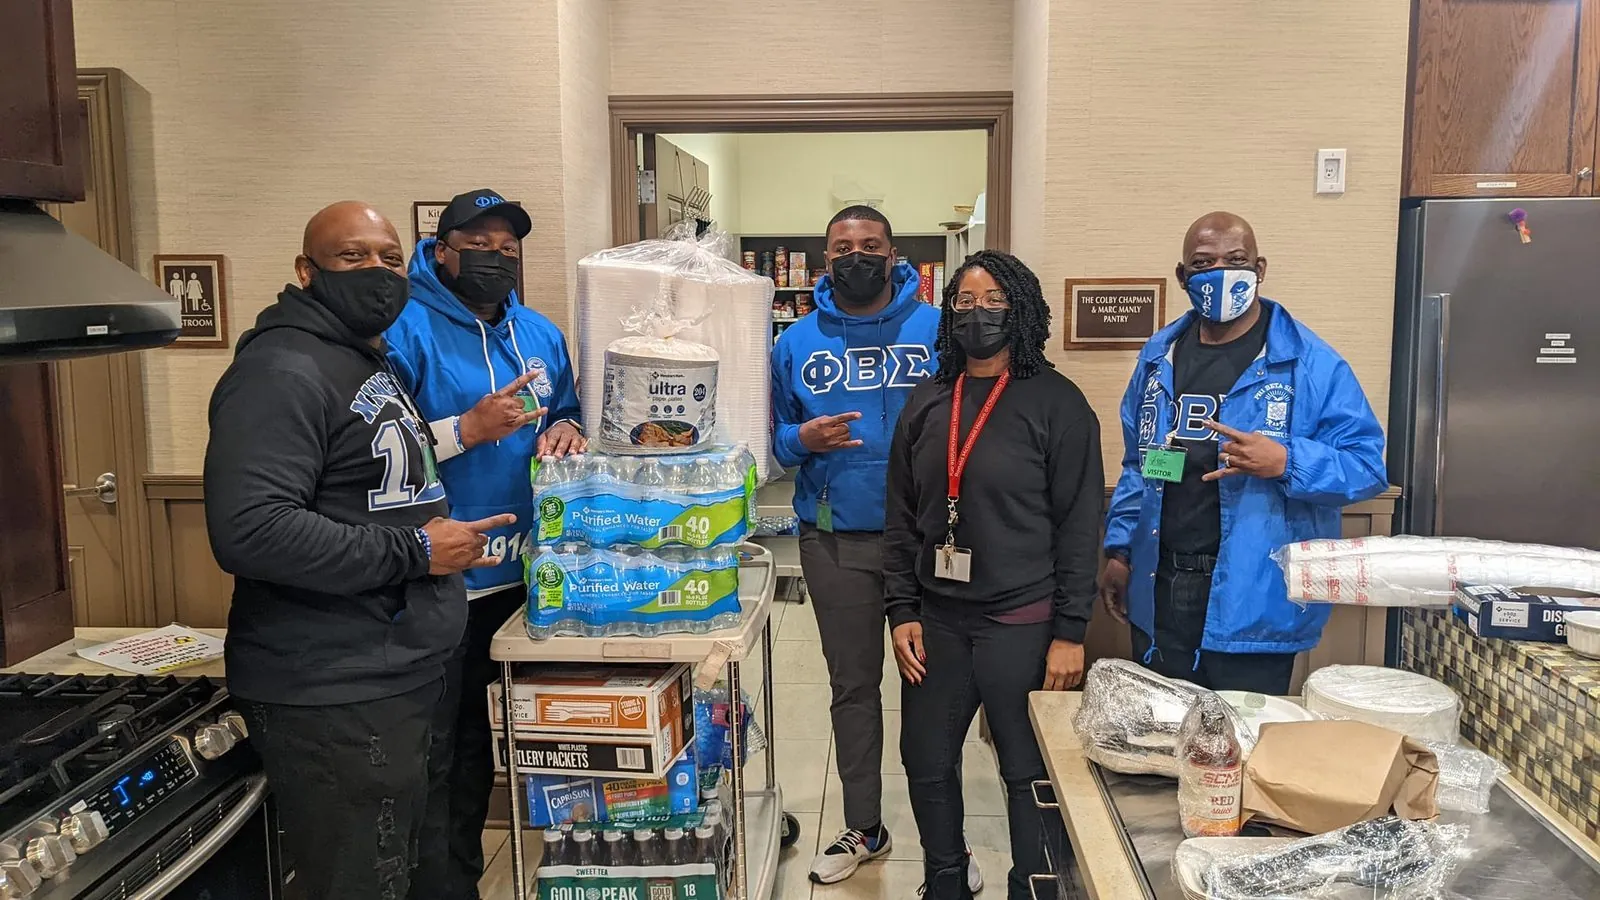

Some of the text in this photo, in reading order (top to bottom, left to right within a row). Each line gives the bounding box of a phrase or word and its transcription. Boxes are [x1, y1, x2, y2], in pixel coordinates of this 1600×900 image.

[428, 209, 440, 218] Kit
[650, 381, 686, 395] ultra
[1264, 382, 1283, 391] BETA
[1284, 384, 1295, 396] SIG
[962, 429, 978, 457] McDonald
[975, 412, 986, 430] House
[1147, 468, 1171, 477] VISITOR
[572, 511, 661, 527] Purified Water
[686, 516, 709, 534] 40
[569, 580, 660, 593] Purified Water
[684, 580, 709, 595] 40
[1543, 610, 1566, 623] DIS
[546, 751, 589, 769] PACKETS
[606, 783, 619, 791] 40
[1211, 796, 1235, 805] RED
[576, 868, 595, 876] SWEET
[550, 886, 637, 900] GOLD PEAK
[652, 888, 670, 896] GOLD
[684, 884, 696, 896] 18
